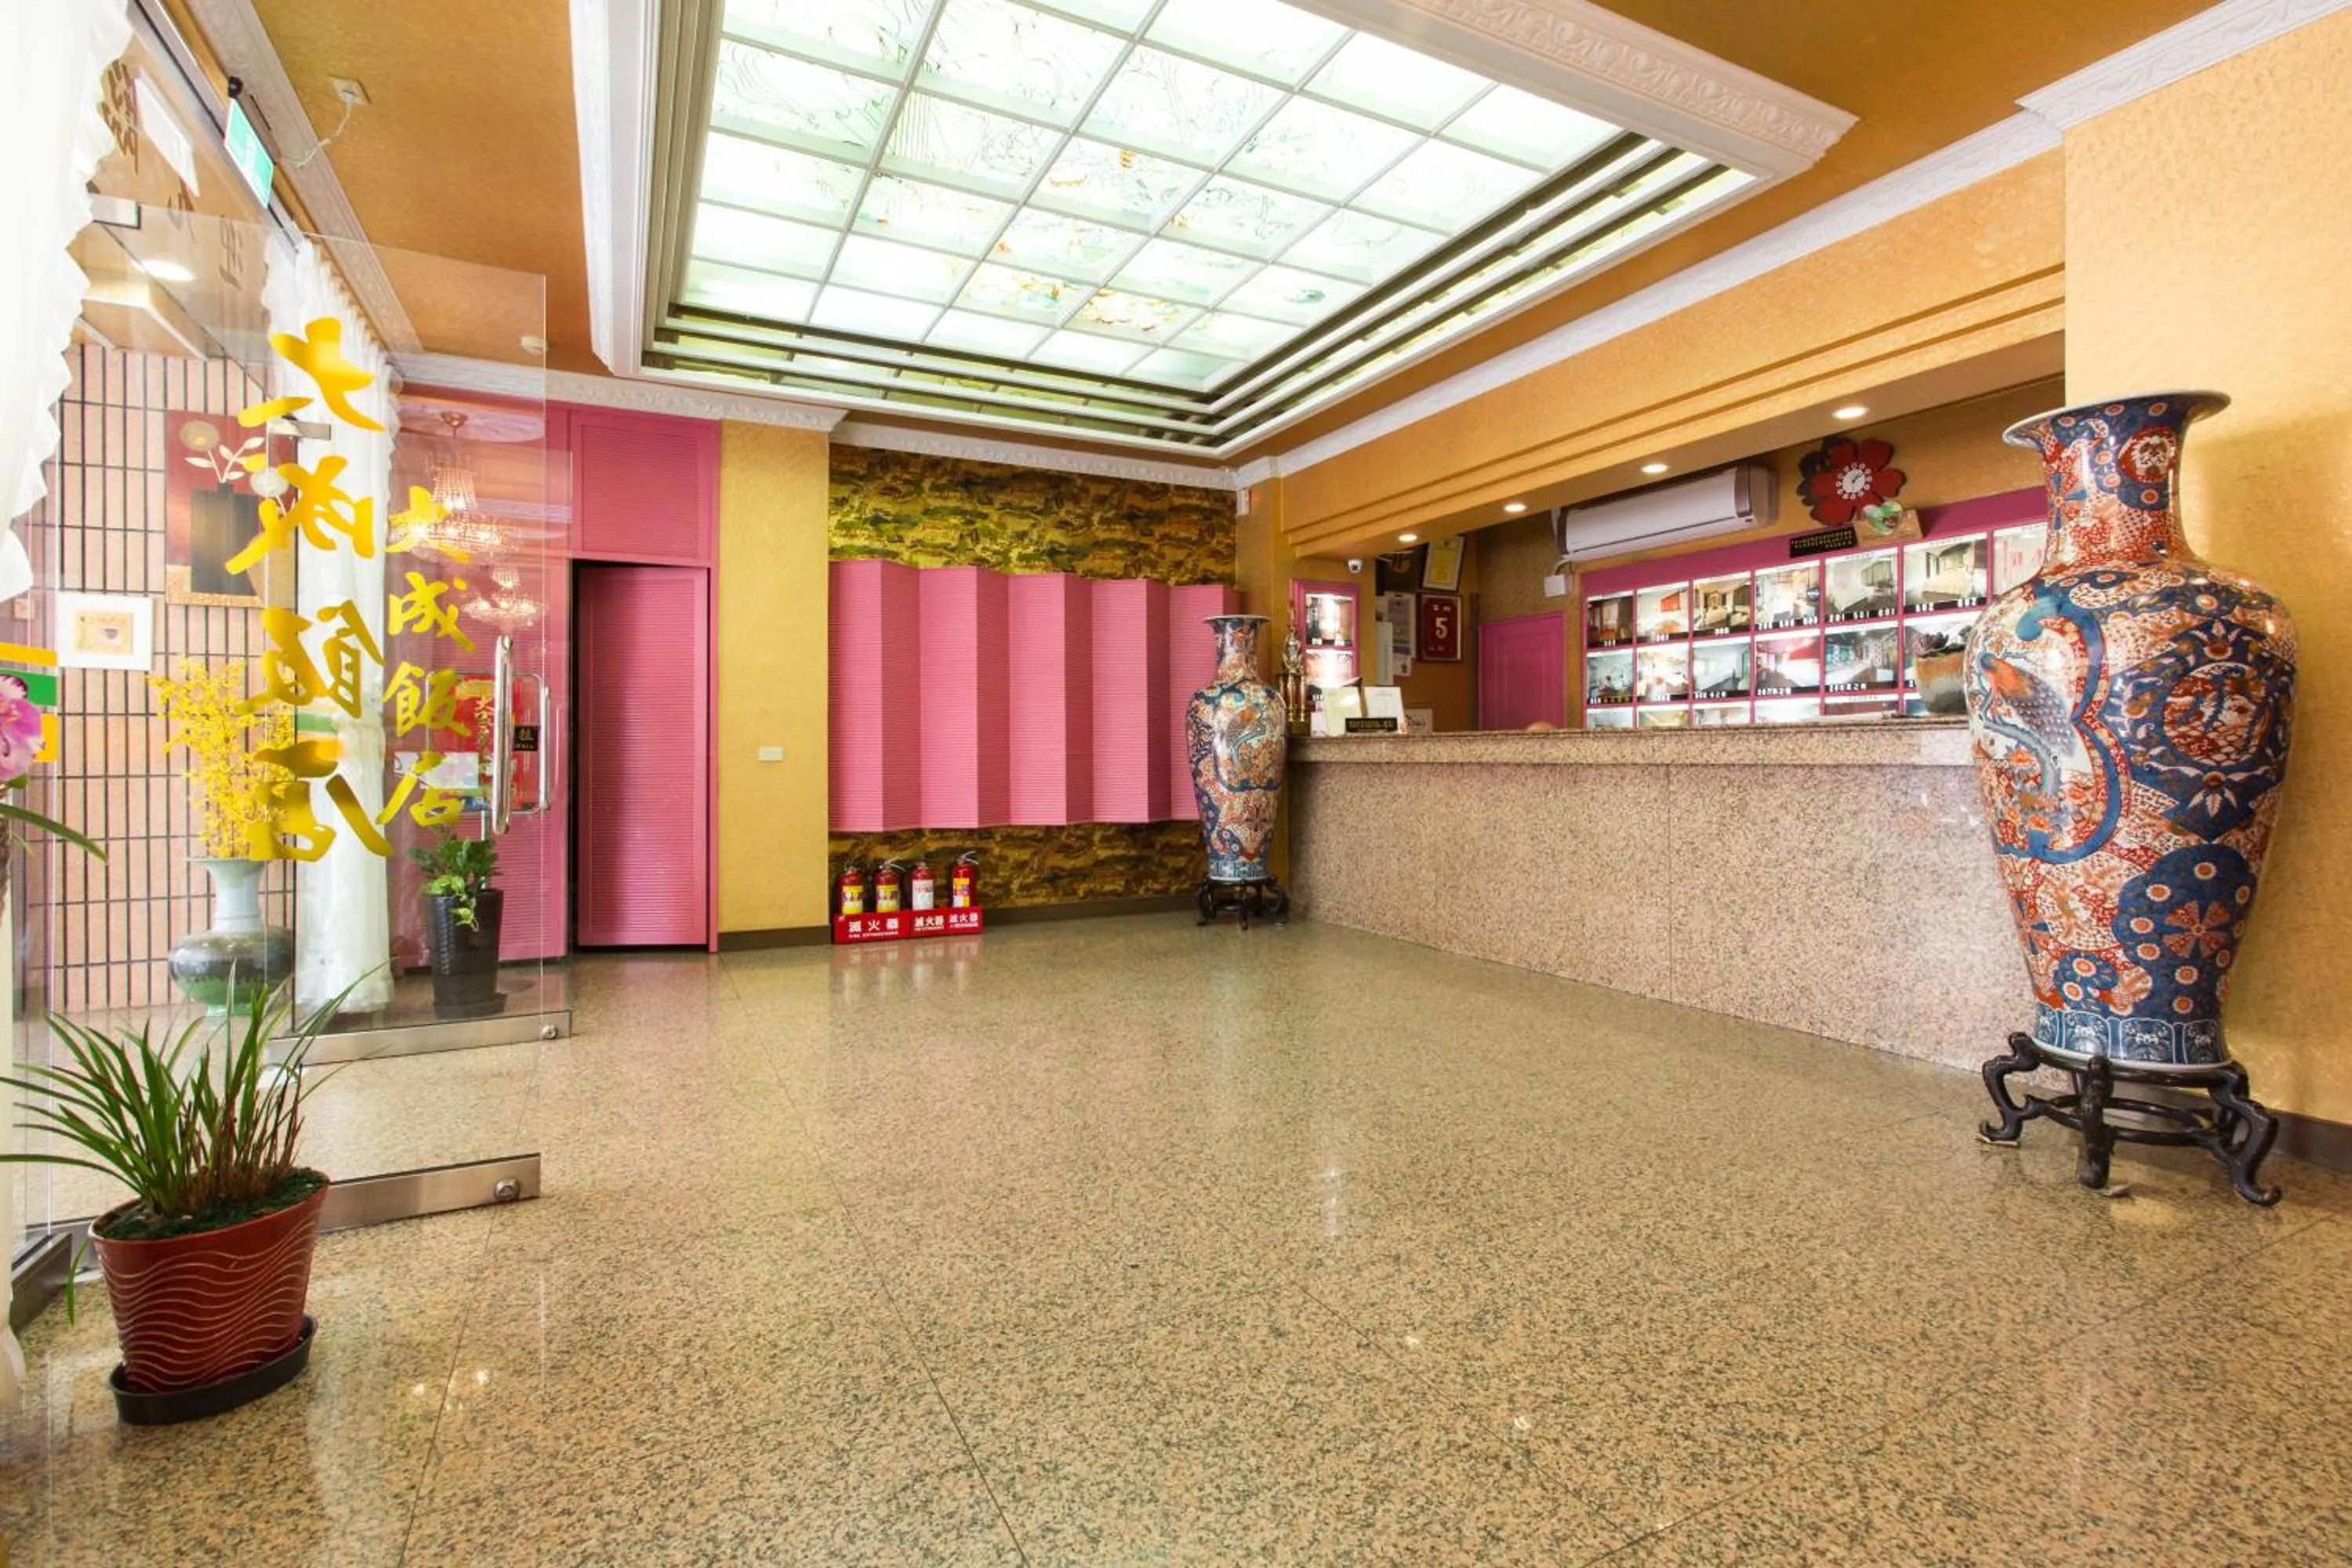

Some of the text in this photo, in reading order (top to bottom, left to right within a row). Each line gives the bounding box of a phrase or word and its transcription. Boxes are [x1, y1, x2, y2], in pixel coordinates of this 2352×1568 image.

[376, 485, 474, 826] 大成飯店
[1435, 617, 1449, 639] 5
